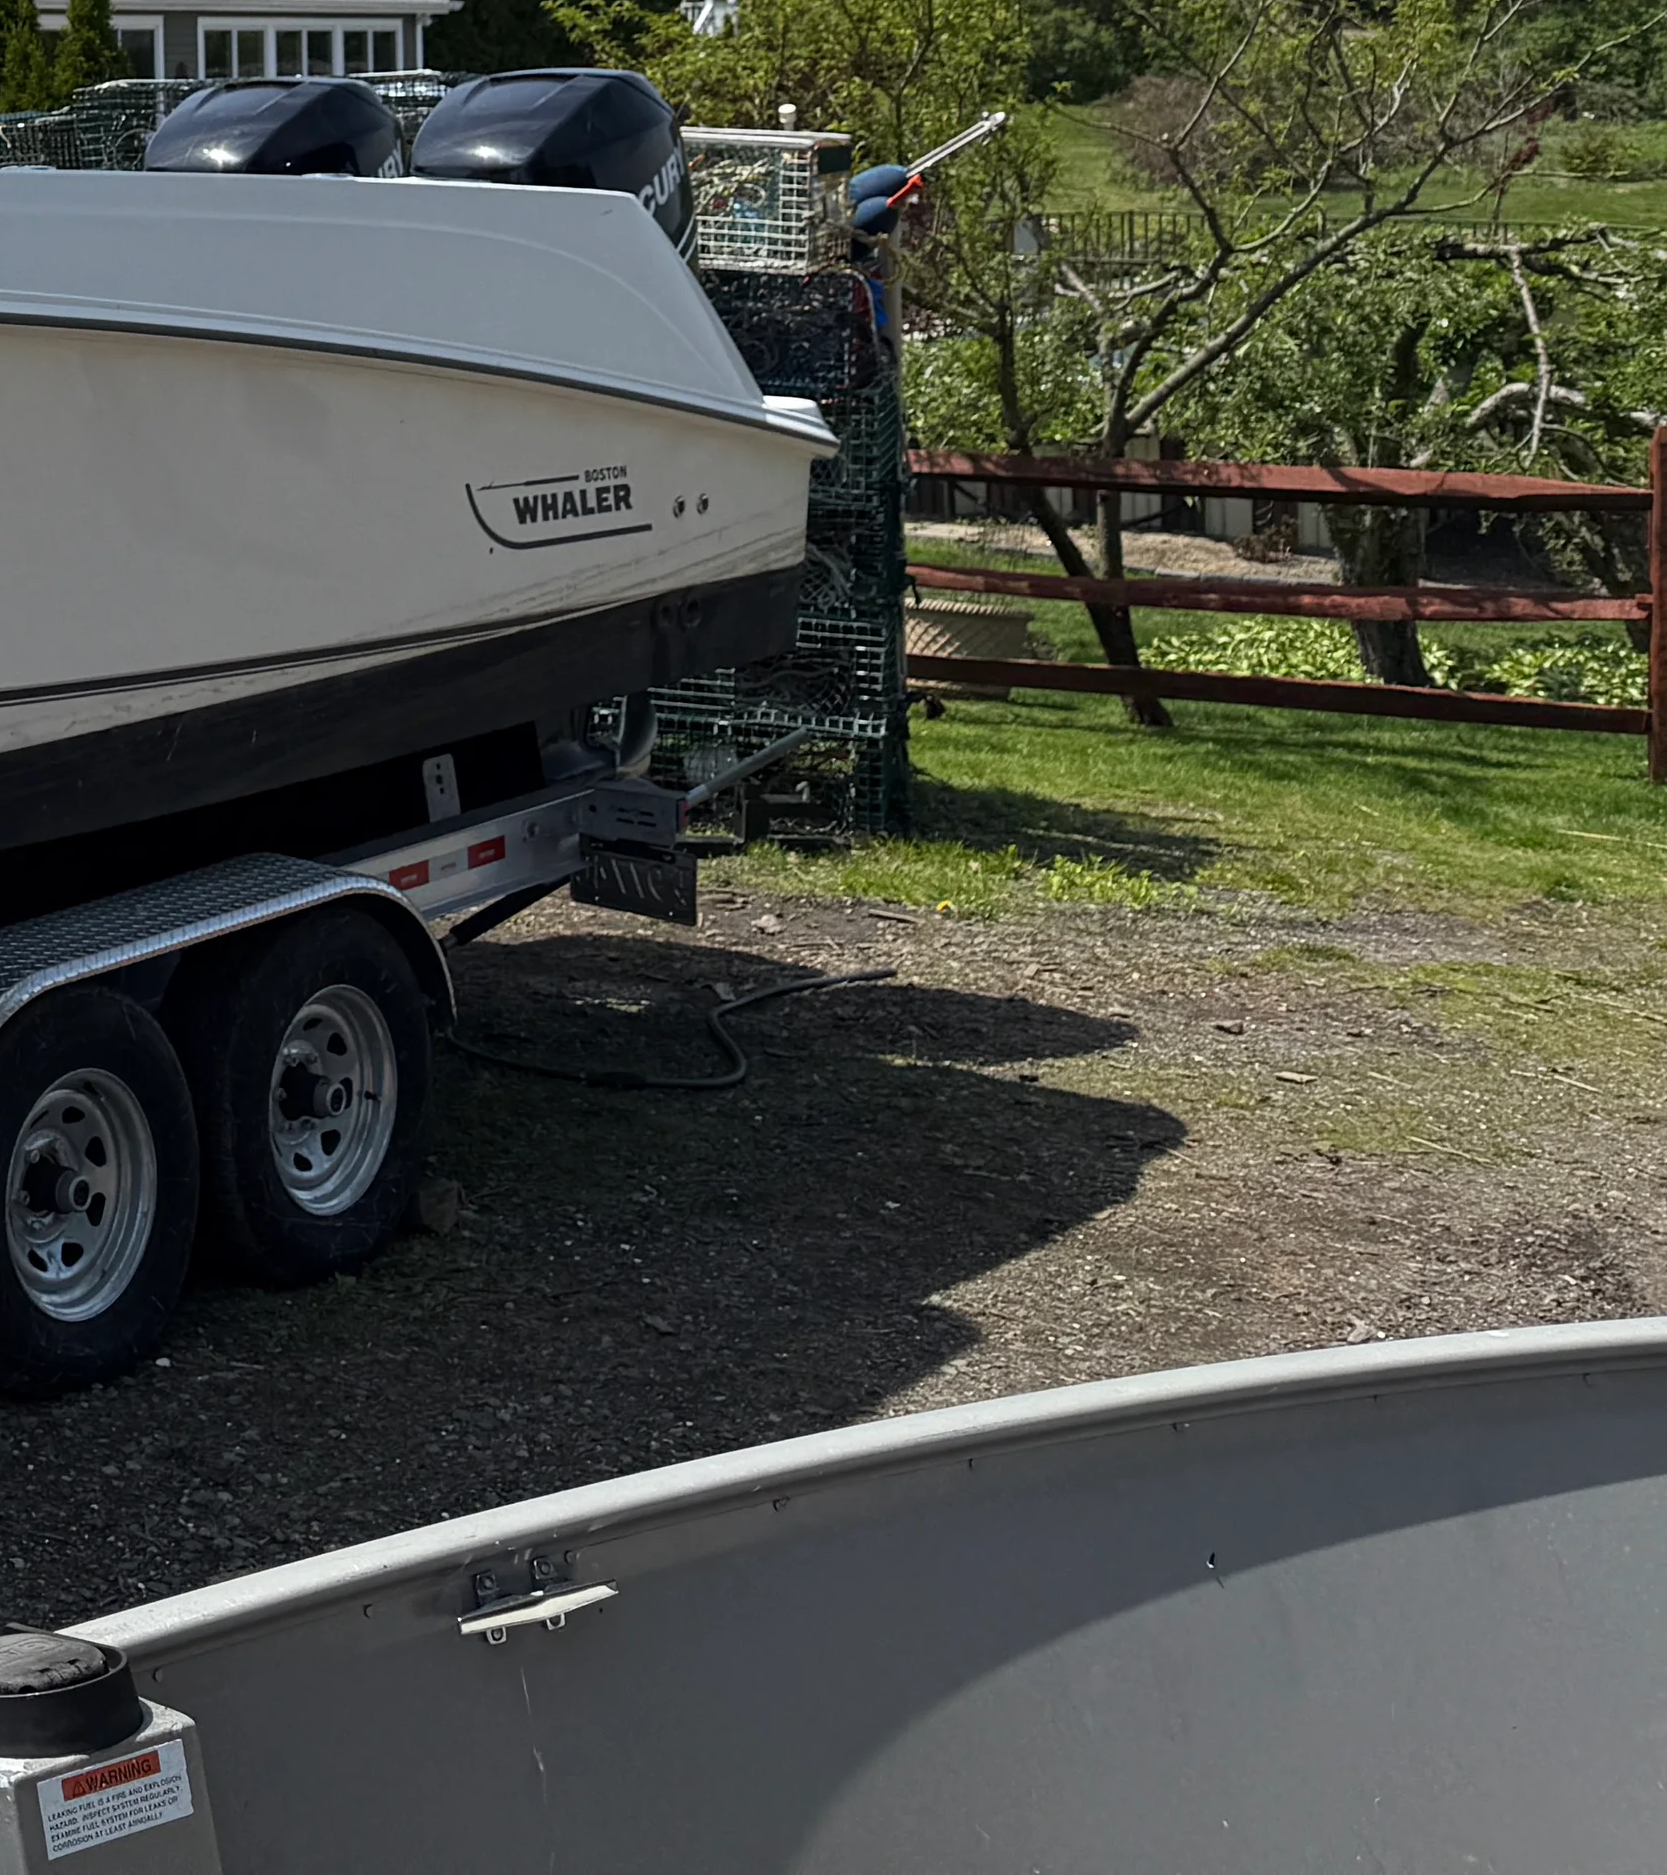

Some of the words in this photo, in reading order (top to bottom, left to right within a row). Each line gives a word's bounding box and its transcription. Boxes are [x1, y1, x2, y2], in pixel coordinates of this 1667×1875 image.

[583, 465, 628, 483] BOSTON
[512, 483, 633, 525] WHALER
[85, 1759, 152, 1792] WARNING
[48, 1807, 78, 1822] LEAKING
[79, 1801, 96, 1811] FUEL
[129, 1786, 143, 1796] AND
[83, 1821, 100, 1832] FUEL
[129, 1806, 144, 1816] FOR
[145, 1799, 167, 1813] LEAKS
[112, 1797, 139, 1812] SYSTEM
[105, 1822, 126, 1836] LEAST
